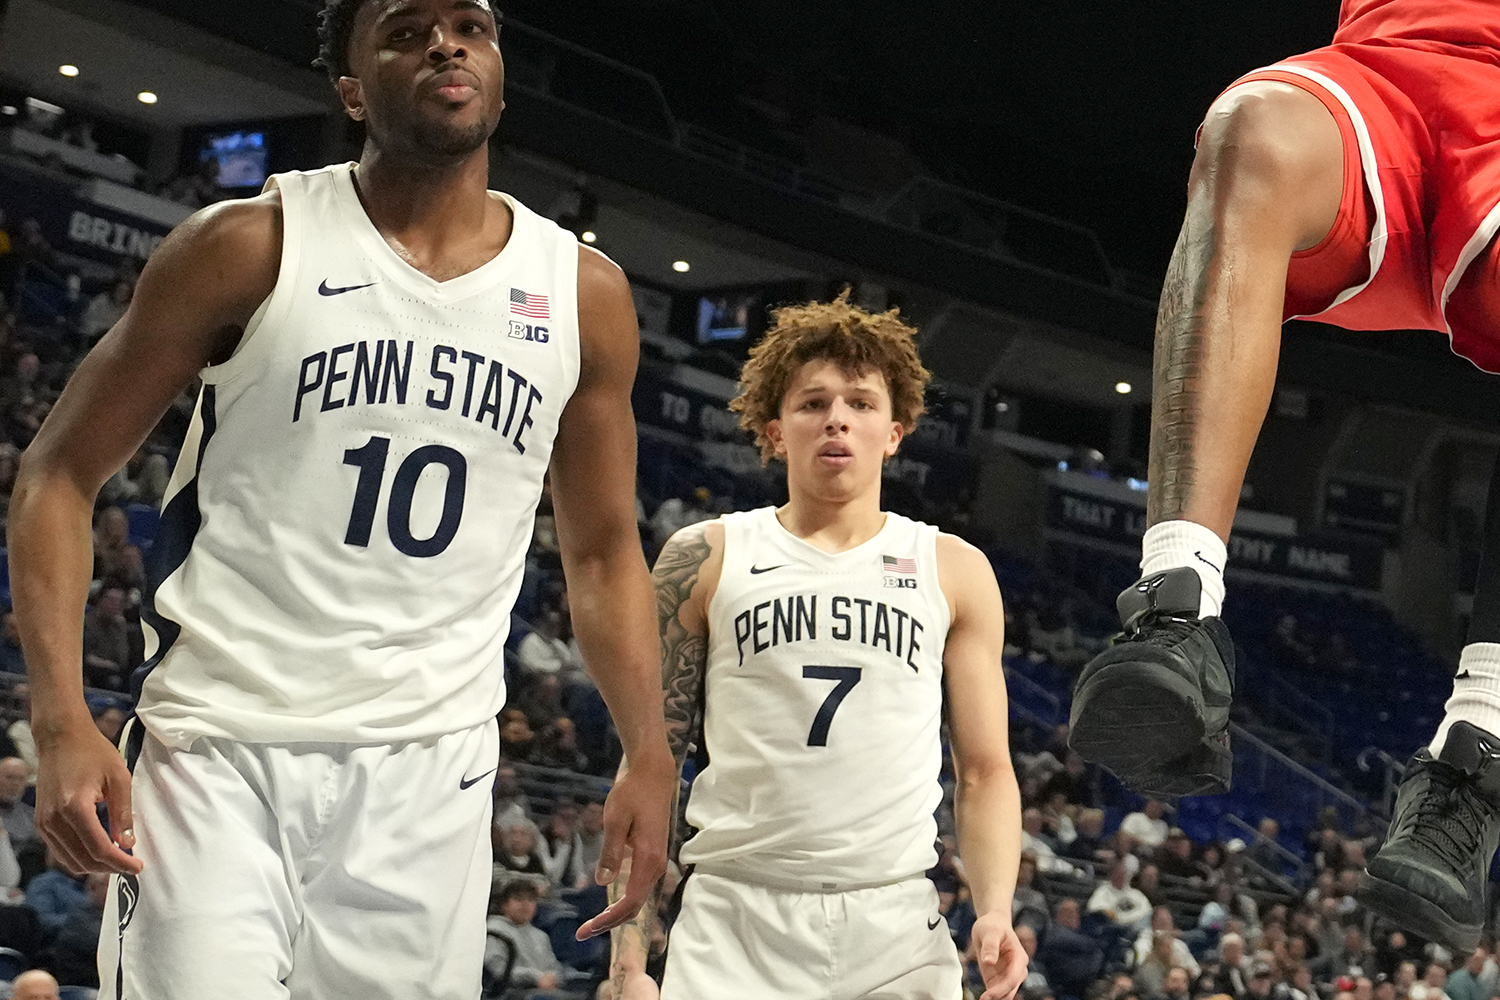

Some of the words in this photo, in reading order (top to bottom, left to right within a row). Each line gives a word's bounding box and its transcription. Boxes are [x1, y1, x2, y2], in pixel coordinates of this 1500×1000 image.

[292, 339, 414, 423] PENN
[425, 344, 543, 455] STATE
[660, 392, 690, 423] TO
[342, 436, 467, 558] 10
[1062, 496, 1117, 528] THAT
[1288, 546, 1351, 576] NAME
[734, 595, 817, 667] PENN
[831, 597, 924, 674] STATE
[802, 665, 862, 747] 7
